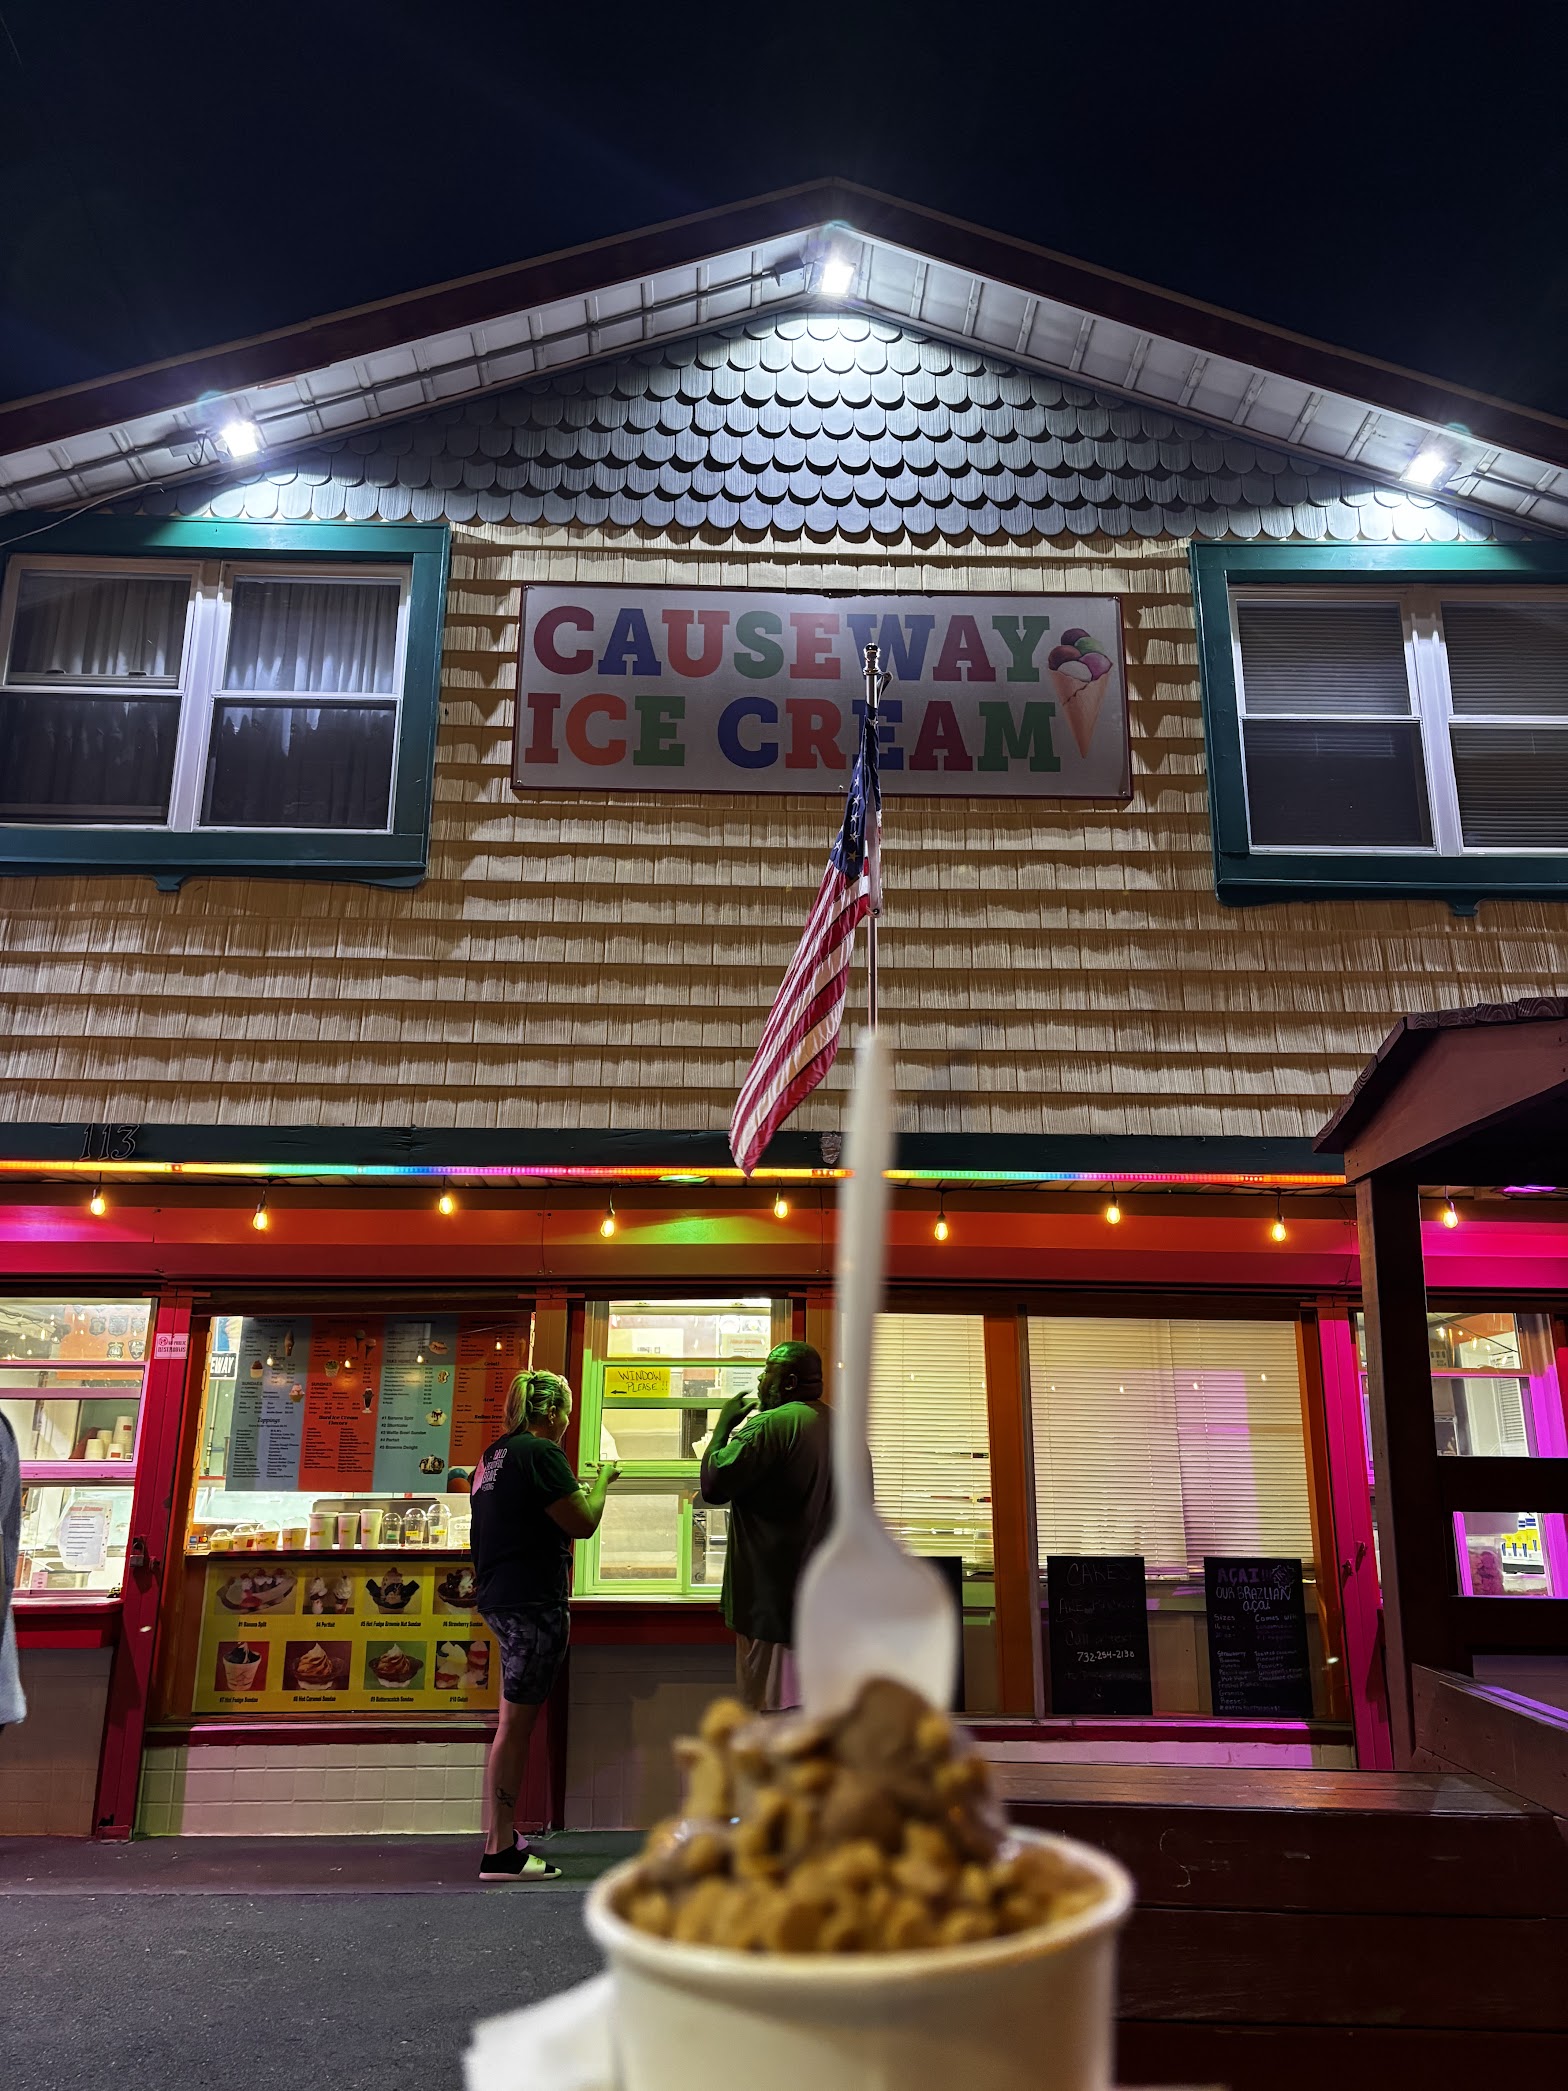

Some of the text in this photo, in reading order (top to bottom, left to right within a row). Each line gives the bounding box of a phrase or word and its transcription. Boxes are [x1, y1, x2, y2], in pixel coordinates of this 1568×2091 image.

[533, 605, 1051, 683] CAUSEWAY
[524, 692, 1062, 773] ICE CREAM
[79, 1123, 140, 1160] 113
[617, 1370, 662, 1381] WINDOW
[626, 1381, 657, 1392] PLEASE
[1216, 1586, 1235, 1600] OUR
[1214, 1613, 1236, 1621] Sizes
[1254, 1613, 1280, 1622] Comes
